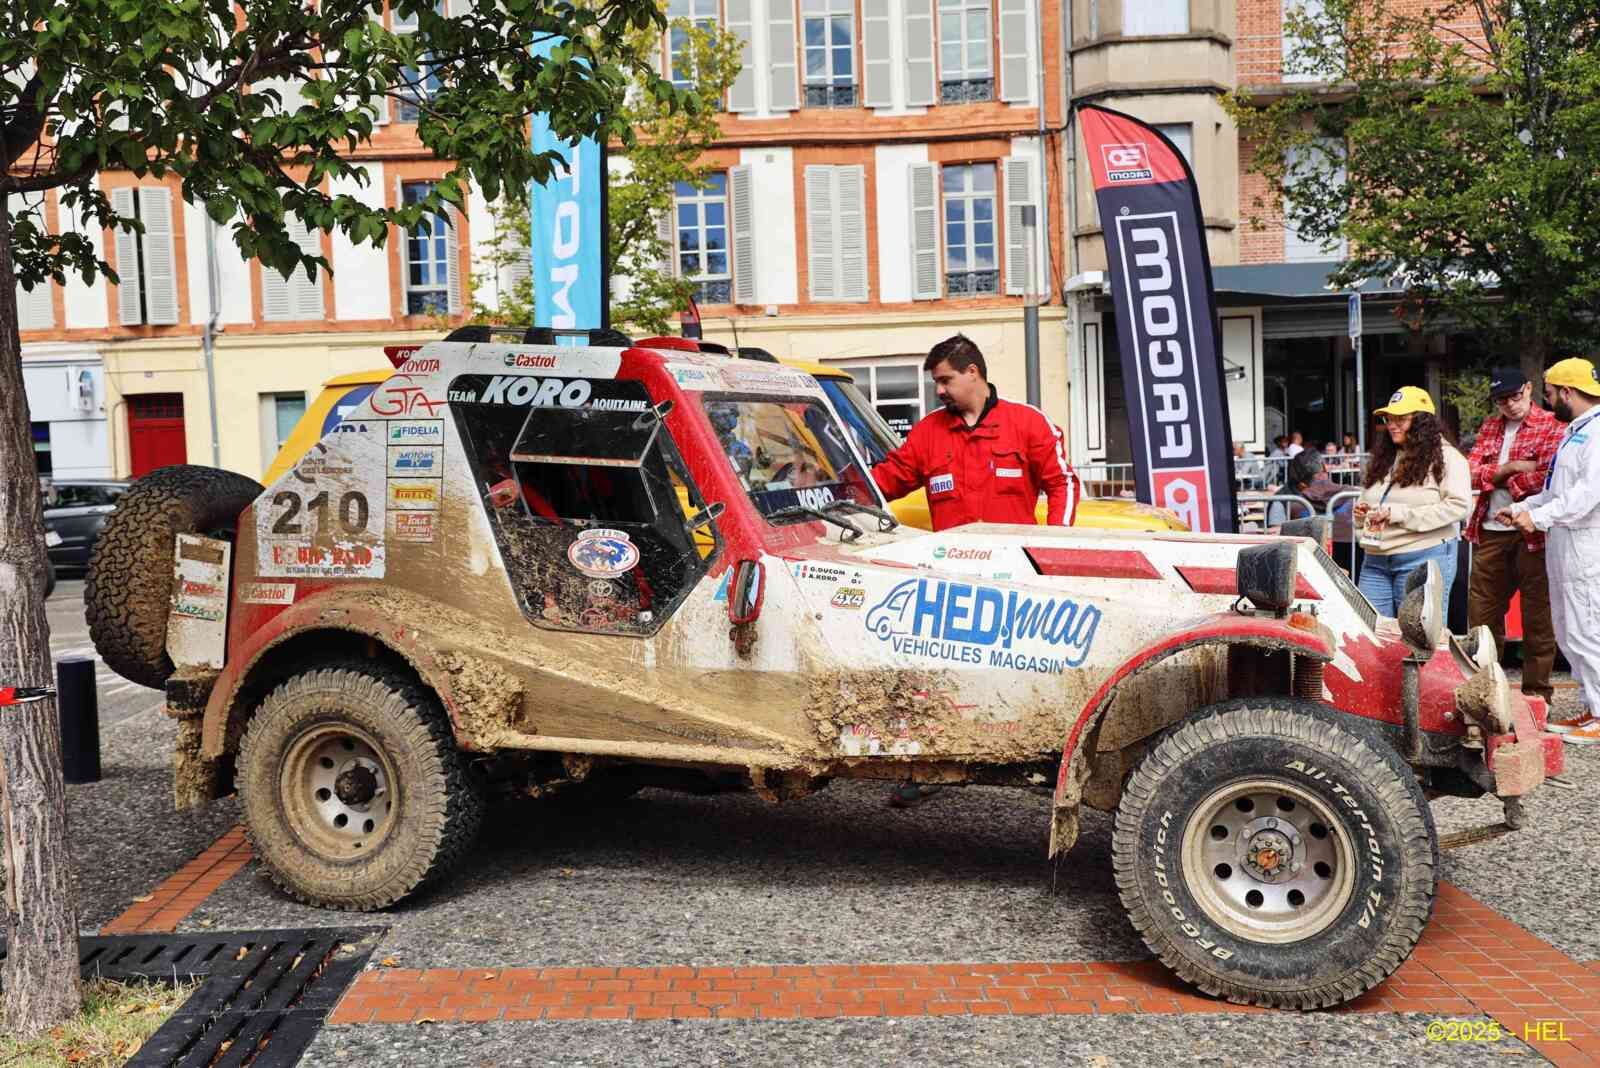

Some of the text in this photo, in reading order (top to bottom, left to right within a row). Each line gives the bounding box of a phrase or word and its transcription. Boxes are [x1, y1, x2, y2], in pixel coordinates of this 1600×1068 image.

[401, 359, 440, 373] TOYOTA
[516, 353, 557, 368] Castrol
[449, 376, 648, 411] TEAM KORO AQUITAINE
[402, 426, 439, 435] FIDELIA
[271, 490, 369, 535] 210
[947, 547, 993, 561] Castrol
[892, 636, 1065, 675] VEHICULES MAGASIN
[1285, 759, 1385, 882] All-Terrain
[1154, 810, 1233, 960] BFGoodrich
